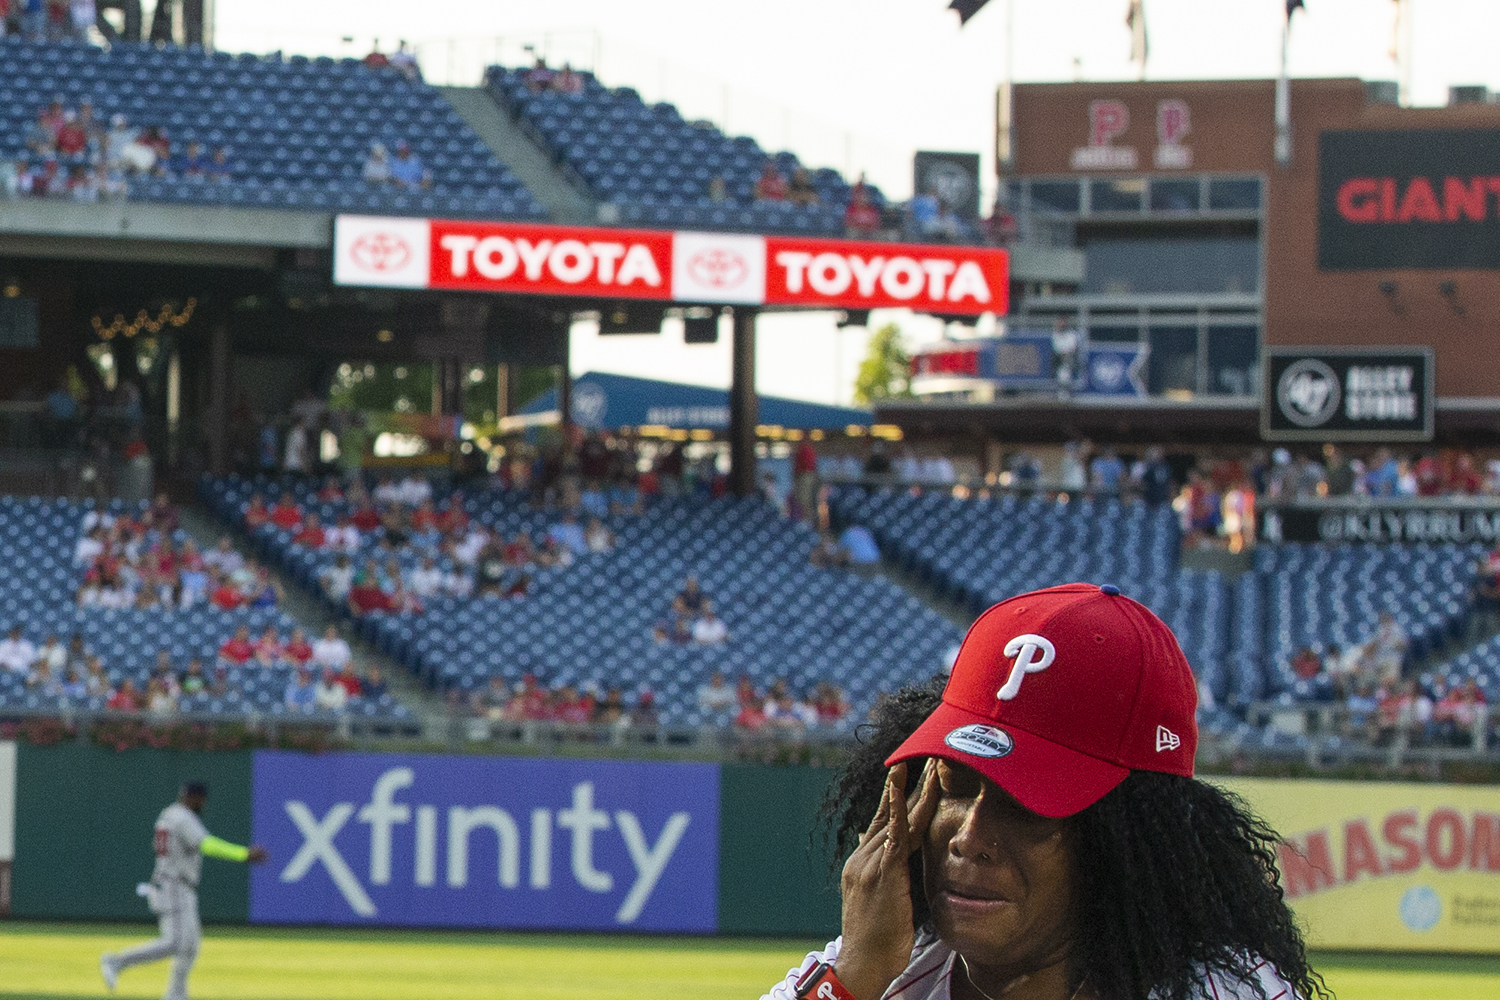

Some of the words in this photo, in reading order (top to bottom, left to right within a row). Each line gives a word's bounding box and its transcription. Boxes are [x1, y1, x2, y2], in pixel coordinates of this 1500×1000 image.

[440, 234, 661, 287] TOYOTA
[777, 251, 991, 303] TOYOTA
[997, 634, 1056, 701] P
[280, 767, 691, 924] xfinity
